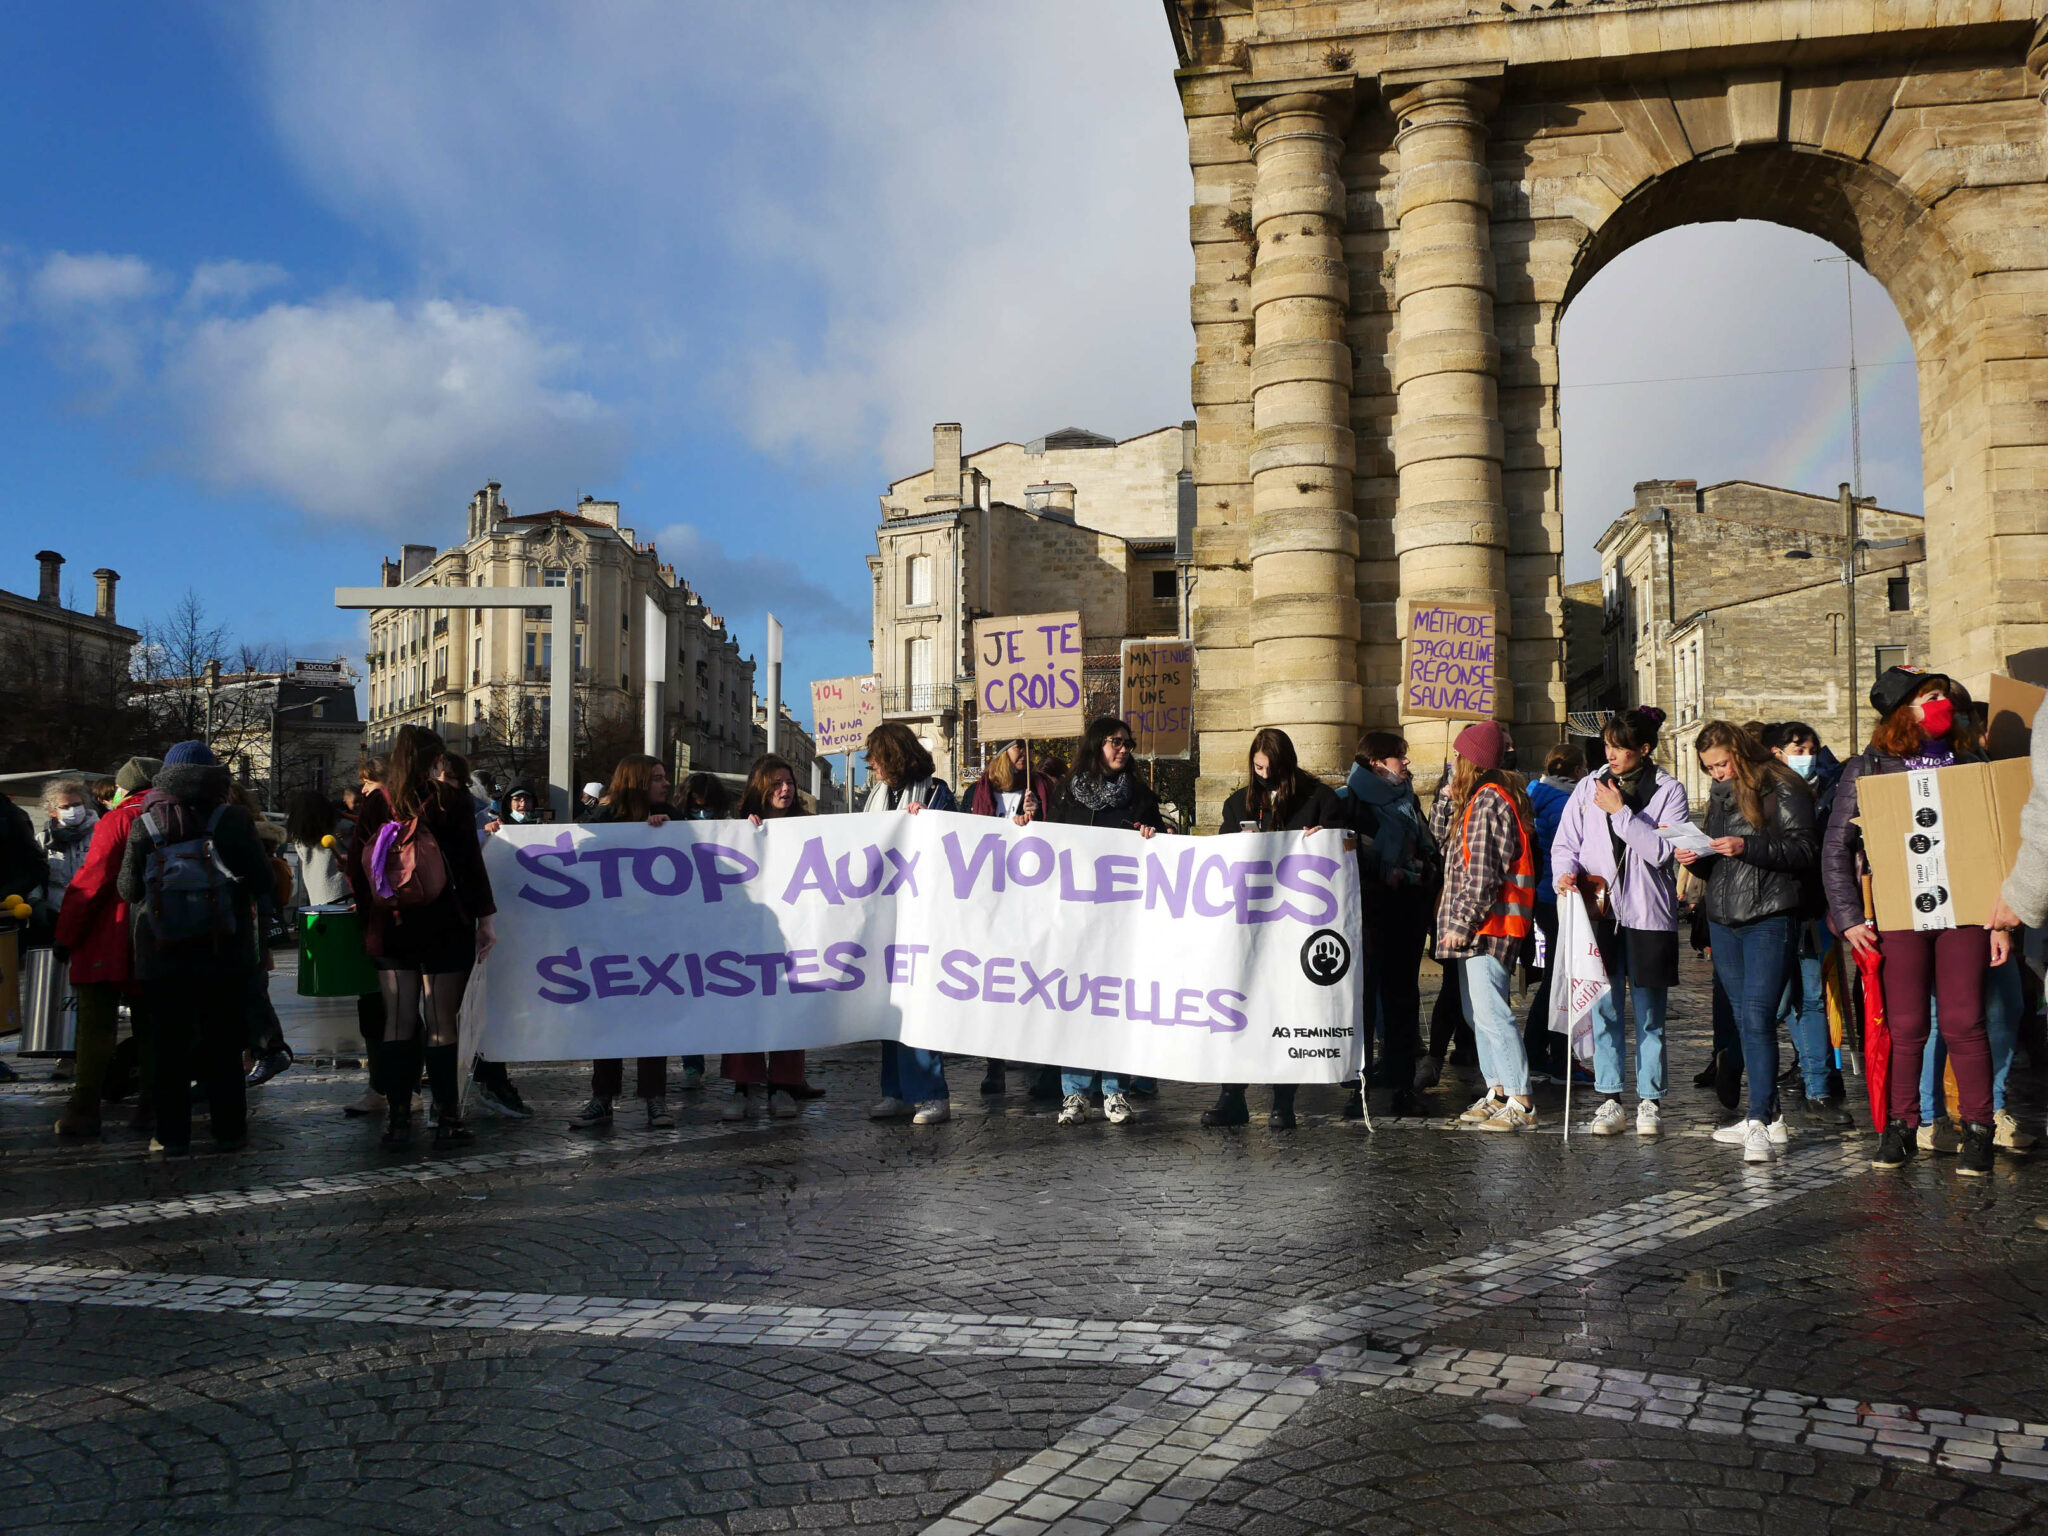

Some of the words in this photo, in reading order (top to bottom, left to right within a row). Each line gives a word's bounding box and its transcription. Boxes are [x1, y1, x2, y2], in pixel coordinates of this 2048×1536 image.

[1414, 607, 1494, 638] MÉTHODE
[983, 629, 1024, 666] JE
[1037, 623, 1083, 656] TE
[1130, 652, 1151, 667] MA
[1152, 648, 1191, 665] TENUE
[303, 663, 334, 671] SOCOSA
[1410, 657, 1495, 689] RÉPONSE
[1127, 673, 1158, 688] N'EST
[1162, 671, 1180, 685] PAS
[815, 685, 842, 701] 104
[1139, 690, 1167, 705] UNE
[1409, 684, 1496, 714] SAUVAGE
[840, 718, 863, 730] UNA
[821, 732, 863, 746] MENOS
[515, 830, 760, 910] STOP
[781, 835, 921, 906] AUX
[940, 830, 1343, 926] VIOLENCES
[535, 940, 868, 1005] SEXISTES
[884, 943, 930, 987] ET
[936, 949, 1249, 1034] SEXUELLES
[1271, 1026, 1291, 1039] AG
[1293, 1026, 1355, 1039] FEMINISTE
[1287, 1046, 1342, 1059] GIRONDE
